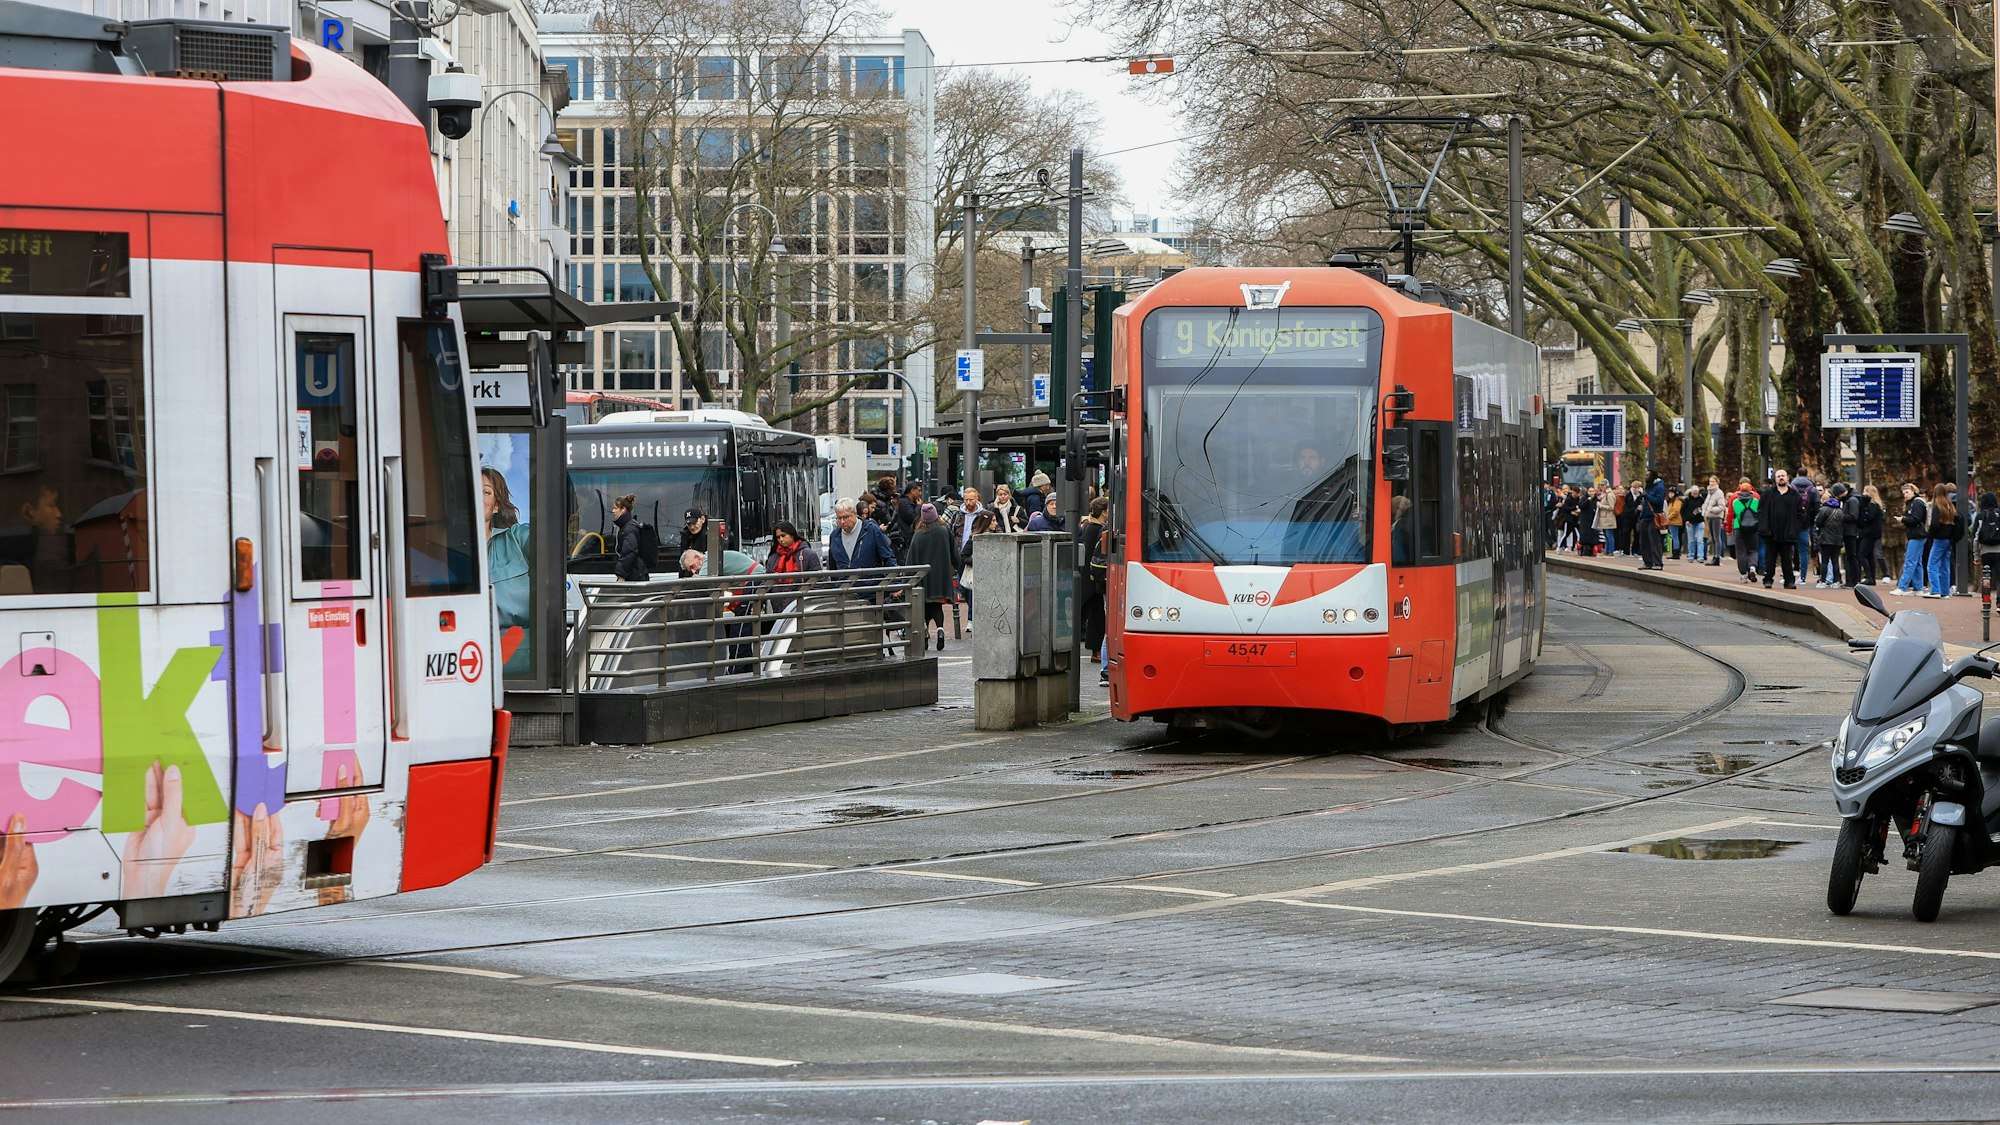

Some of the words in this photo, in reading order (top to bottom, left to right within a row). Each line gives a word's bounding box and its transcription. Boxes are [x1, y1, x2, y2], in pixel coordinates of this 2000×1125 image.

[323, 19, 344, 50] R
[1177, 320, 1193, 355] 9
[1207, 320, 1359, 354] Königsforst
[305, 354, 337, 397] U
[1674, 422, 1682, 432] 4
[1233, 593, 1255, 603] KVB
[309, 611, 324, 623] Kein
[324, 610, 350, 623] Einstieg
[1227, 643, 1268, 656] 4547
[425, 652, 458, 678] KVB
